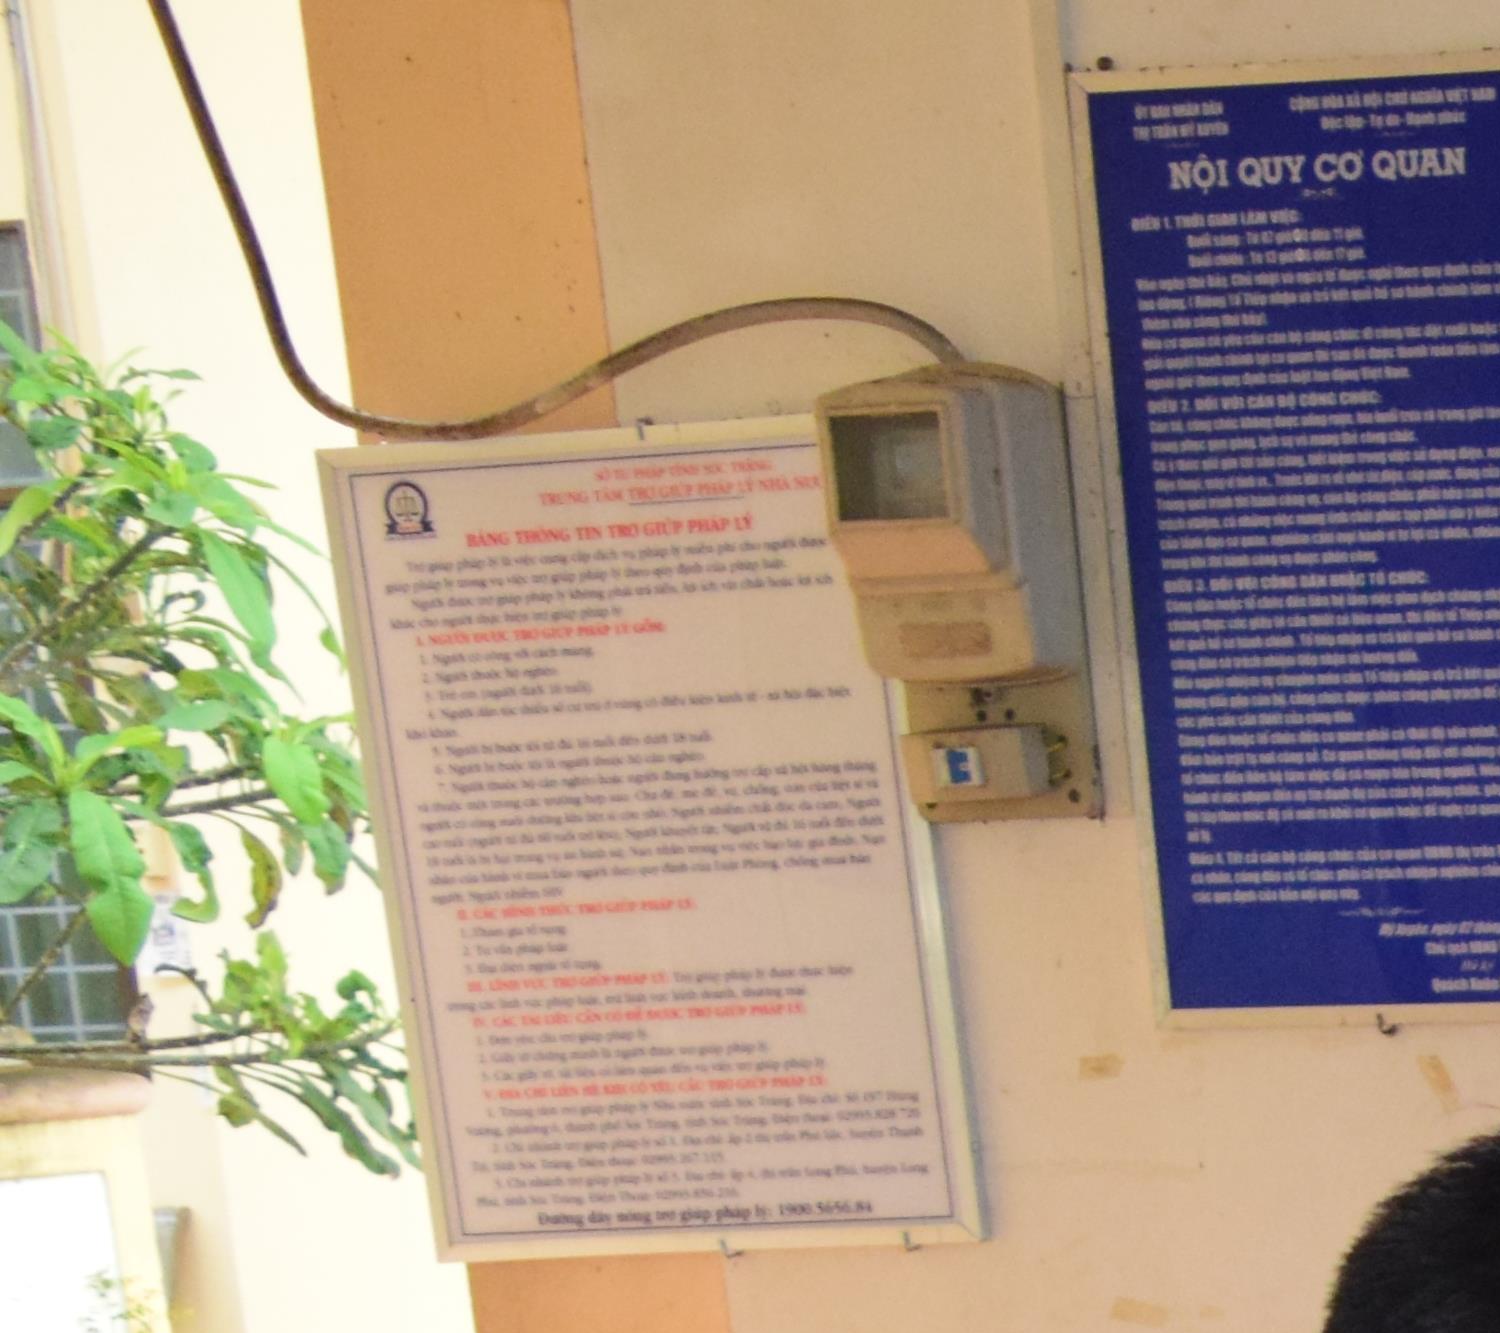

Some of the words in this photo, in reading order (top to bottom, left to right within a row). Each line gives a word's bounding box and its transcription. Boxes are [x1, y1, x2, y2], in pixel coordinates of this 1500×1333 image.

[1169, 153, 1230, 195] NỘI
[1238, 155, 1306, 188] QUY
[1314, 150, 1364, 182] CƠ
[1372, 147, 1467, 181] QUAN
